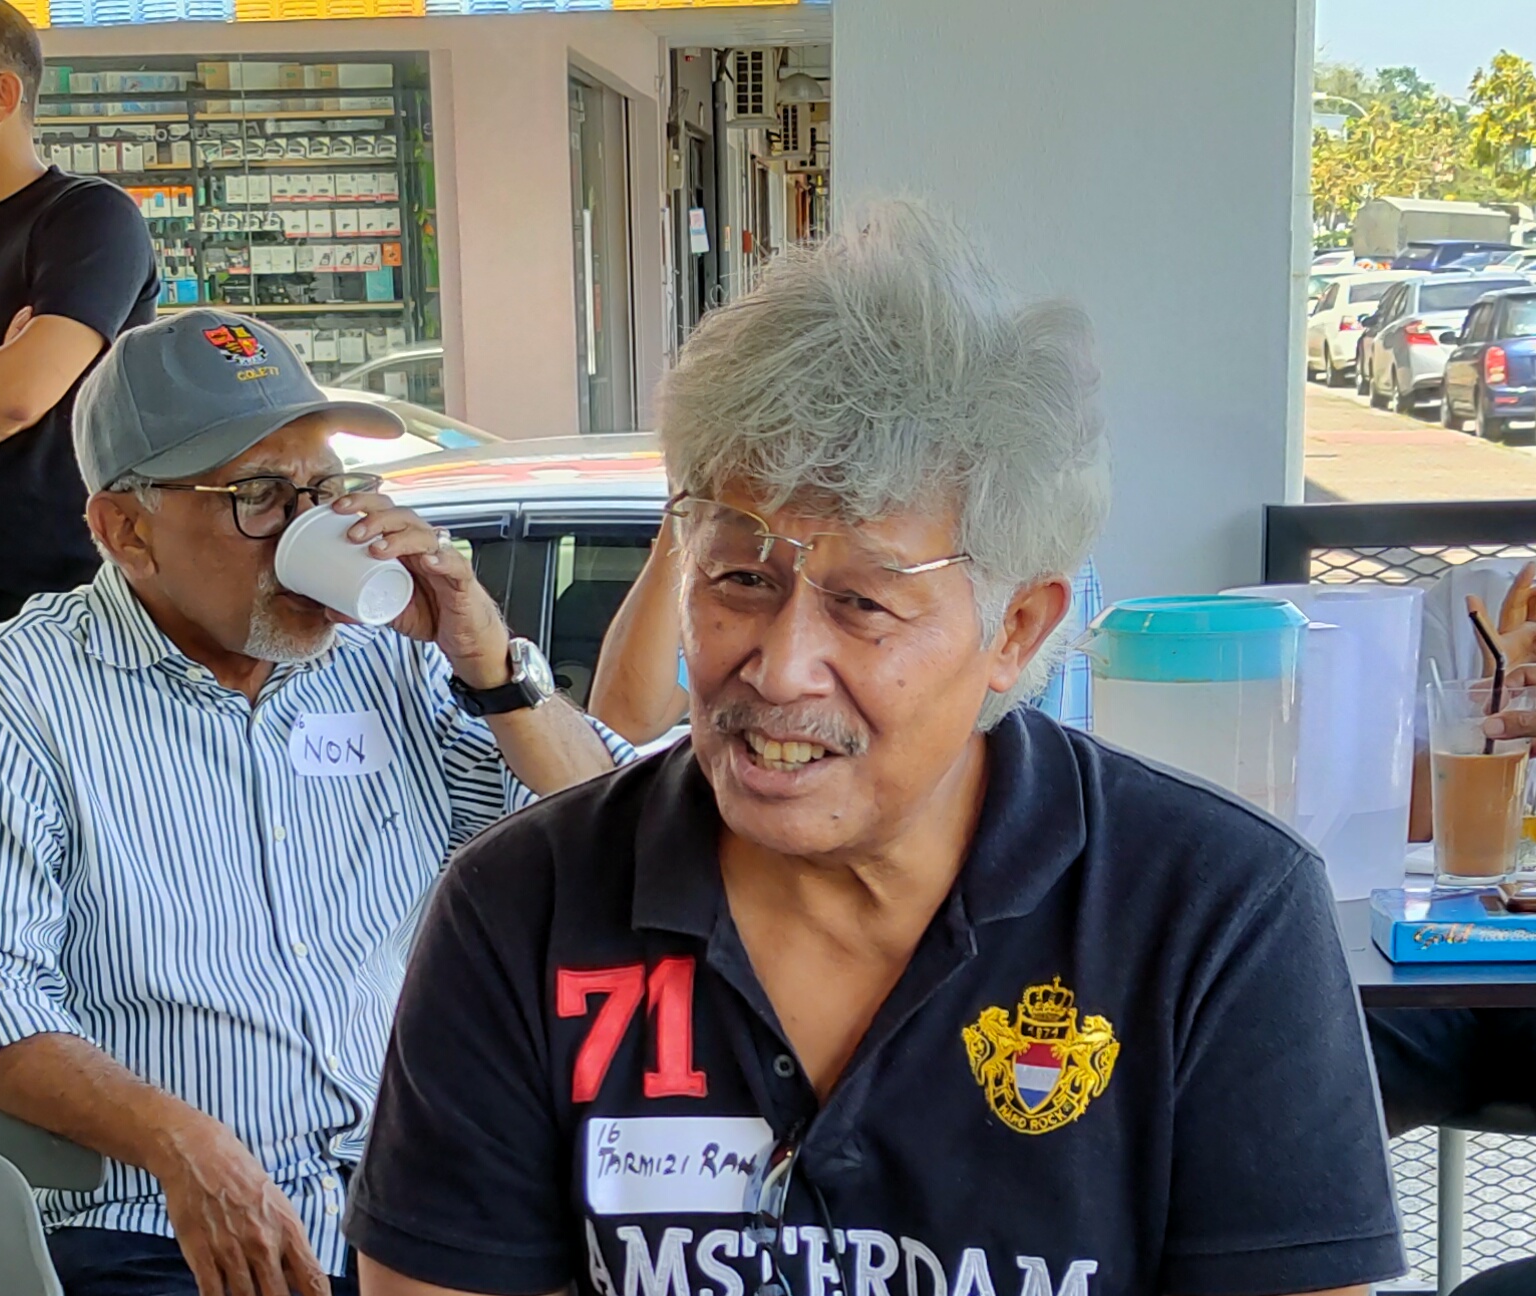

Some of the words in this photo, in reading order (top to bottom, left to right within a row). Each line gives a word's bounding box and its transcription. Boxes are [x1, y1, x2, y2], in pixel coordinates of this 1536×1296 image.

[304, 734, 364, 764] NON
[556, 957, 708, 1103] 71
[597, 1123, 621, 1146] 16
